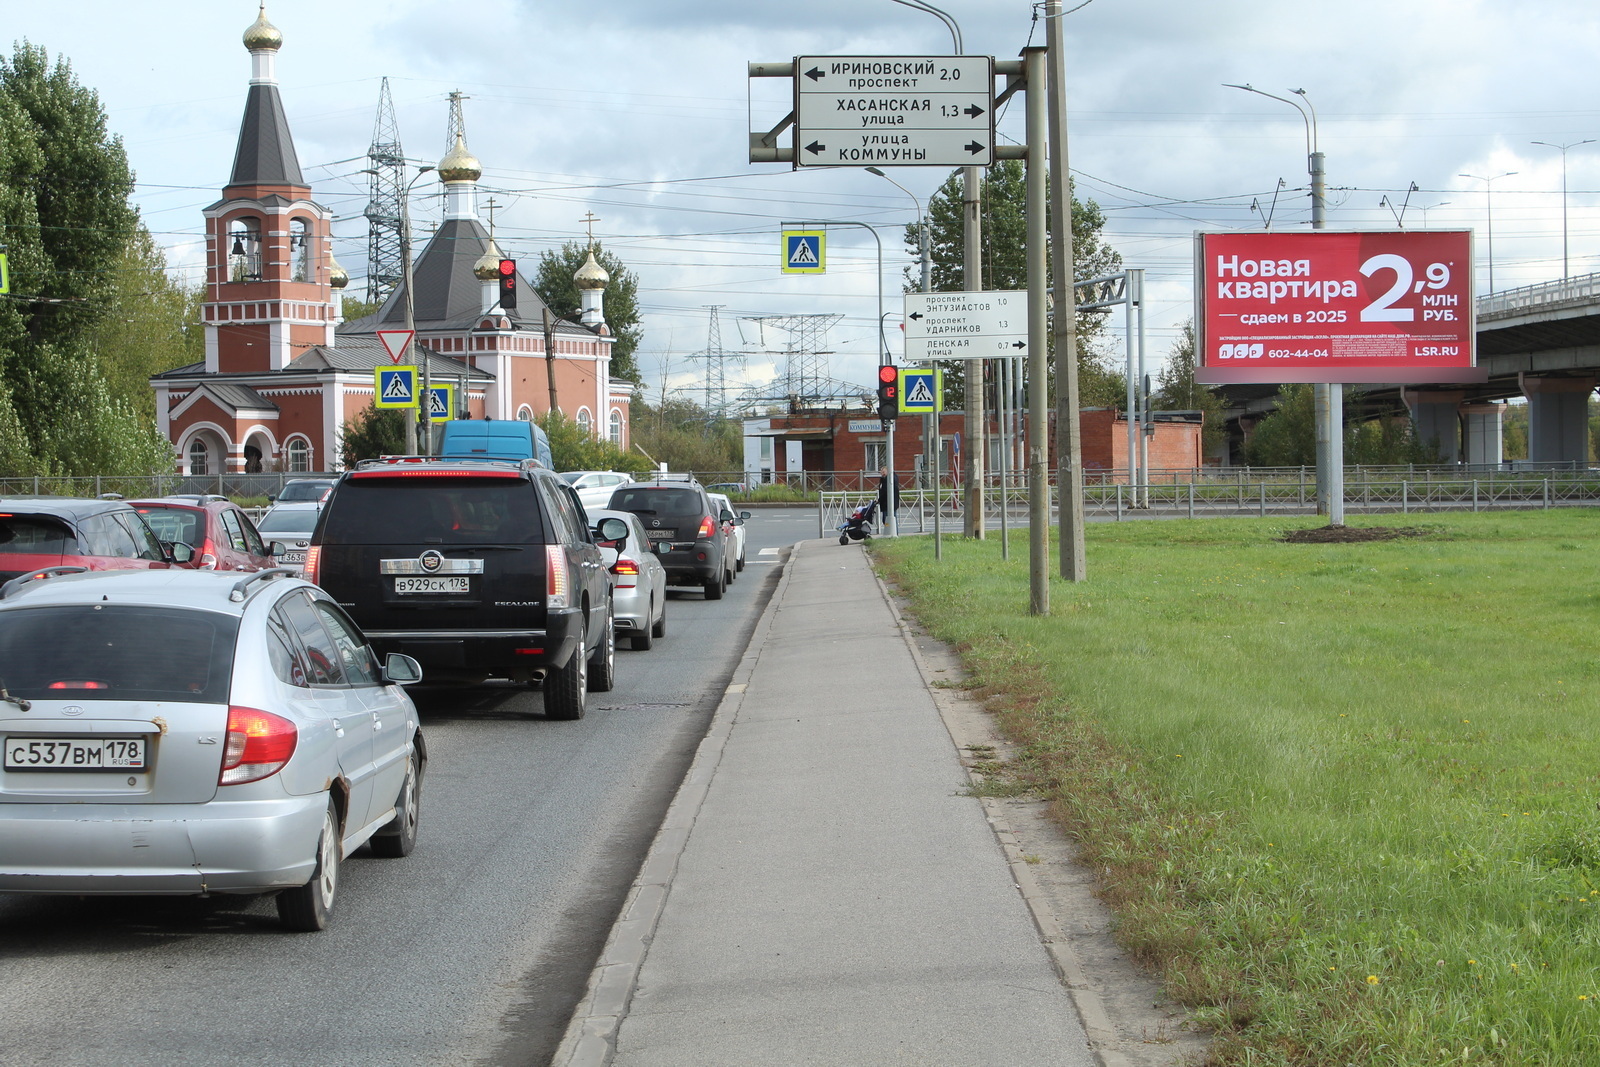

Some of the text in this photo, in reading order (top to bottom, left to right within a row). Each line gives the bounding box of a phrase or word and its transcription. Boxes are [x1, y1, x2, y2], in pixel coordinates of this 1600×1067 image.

[831, 60, 935, 75] ИРИНОВСКИЙ
[940, 69, 961, 82] 2,0
[849, 77, 918, 90] проспект
[837, 99, 931, 111] ХАСАНСКАЯ
[941, 105, 959, 118] 1,3
[862, 114, 904, 127] улица
[862, 134, 909, 147] улица
[839, 149, 926, 160] КОММУНЫ
[1217, 255, 1310, 277] Новая
[1218, 281, 1357, 303] квартира
[926, 296, 966, 304] проспект
[1423, 294, 1458, 306] МЛН
[926, 303, 991, 312] ЭНТУЗИАСТОВ
[926, 317, 966, 325] проспект
[1240, 311, 1347, 325] сдаем в 2025
[1423, 309, 1458, 321] РУБ.
[926, 325, 981, 334] УДАРНИКОВ
[927, 340, 970, 348] ЛЕНСКАЯ
[926, 349, 952, 357] улица
[1268, 349, 1329, 358] 602-44-04
[1415, 346, 1458, 356] LSR.RU
[448, 578, 466, 588] 178
[12, 741, 139, 765] С537ВМ 178
[112, 758, 129, 766] RUS
